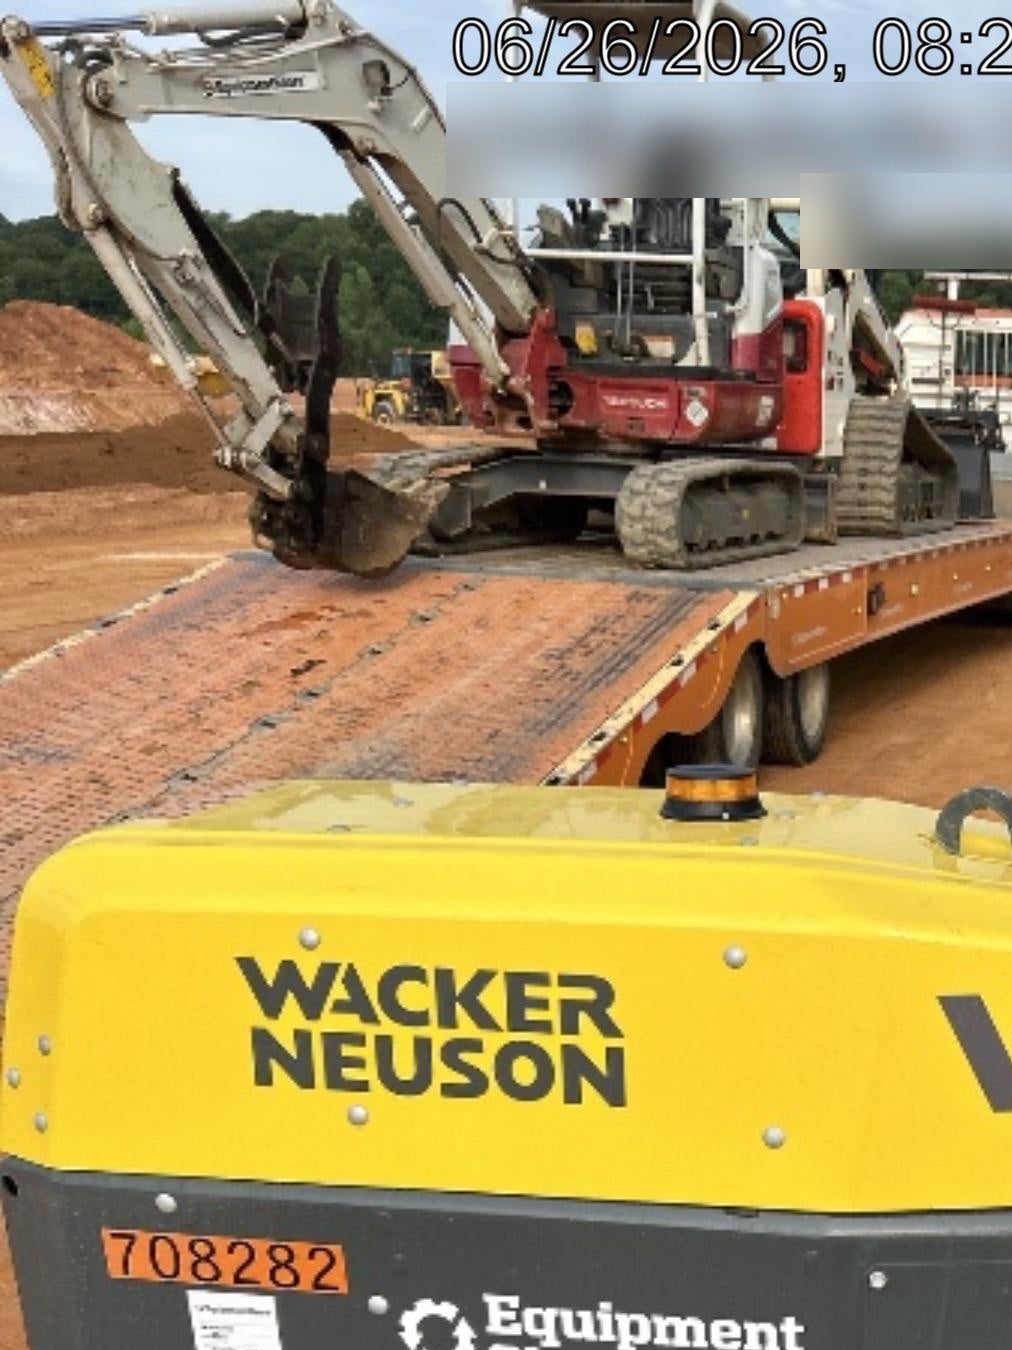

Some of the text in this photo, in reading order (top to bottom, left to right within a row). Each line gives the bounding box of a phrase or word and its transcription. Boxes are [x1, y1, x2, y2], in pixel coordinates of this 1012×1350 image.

[233, 956, 625, 1039] WACKER
[250, 1026, 628, 1109] NEUSON
[109, 1232, 340, 1291] 708282
